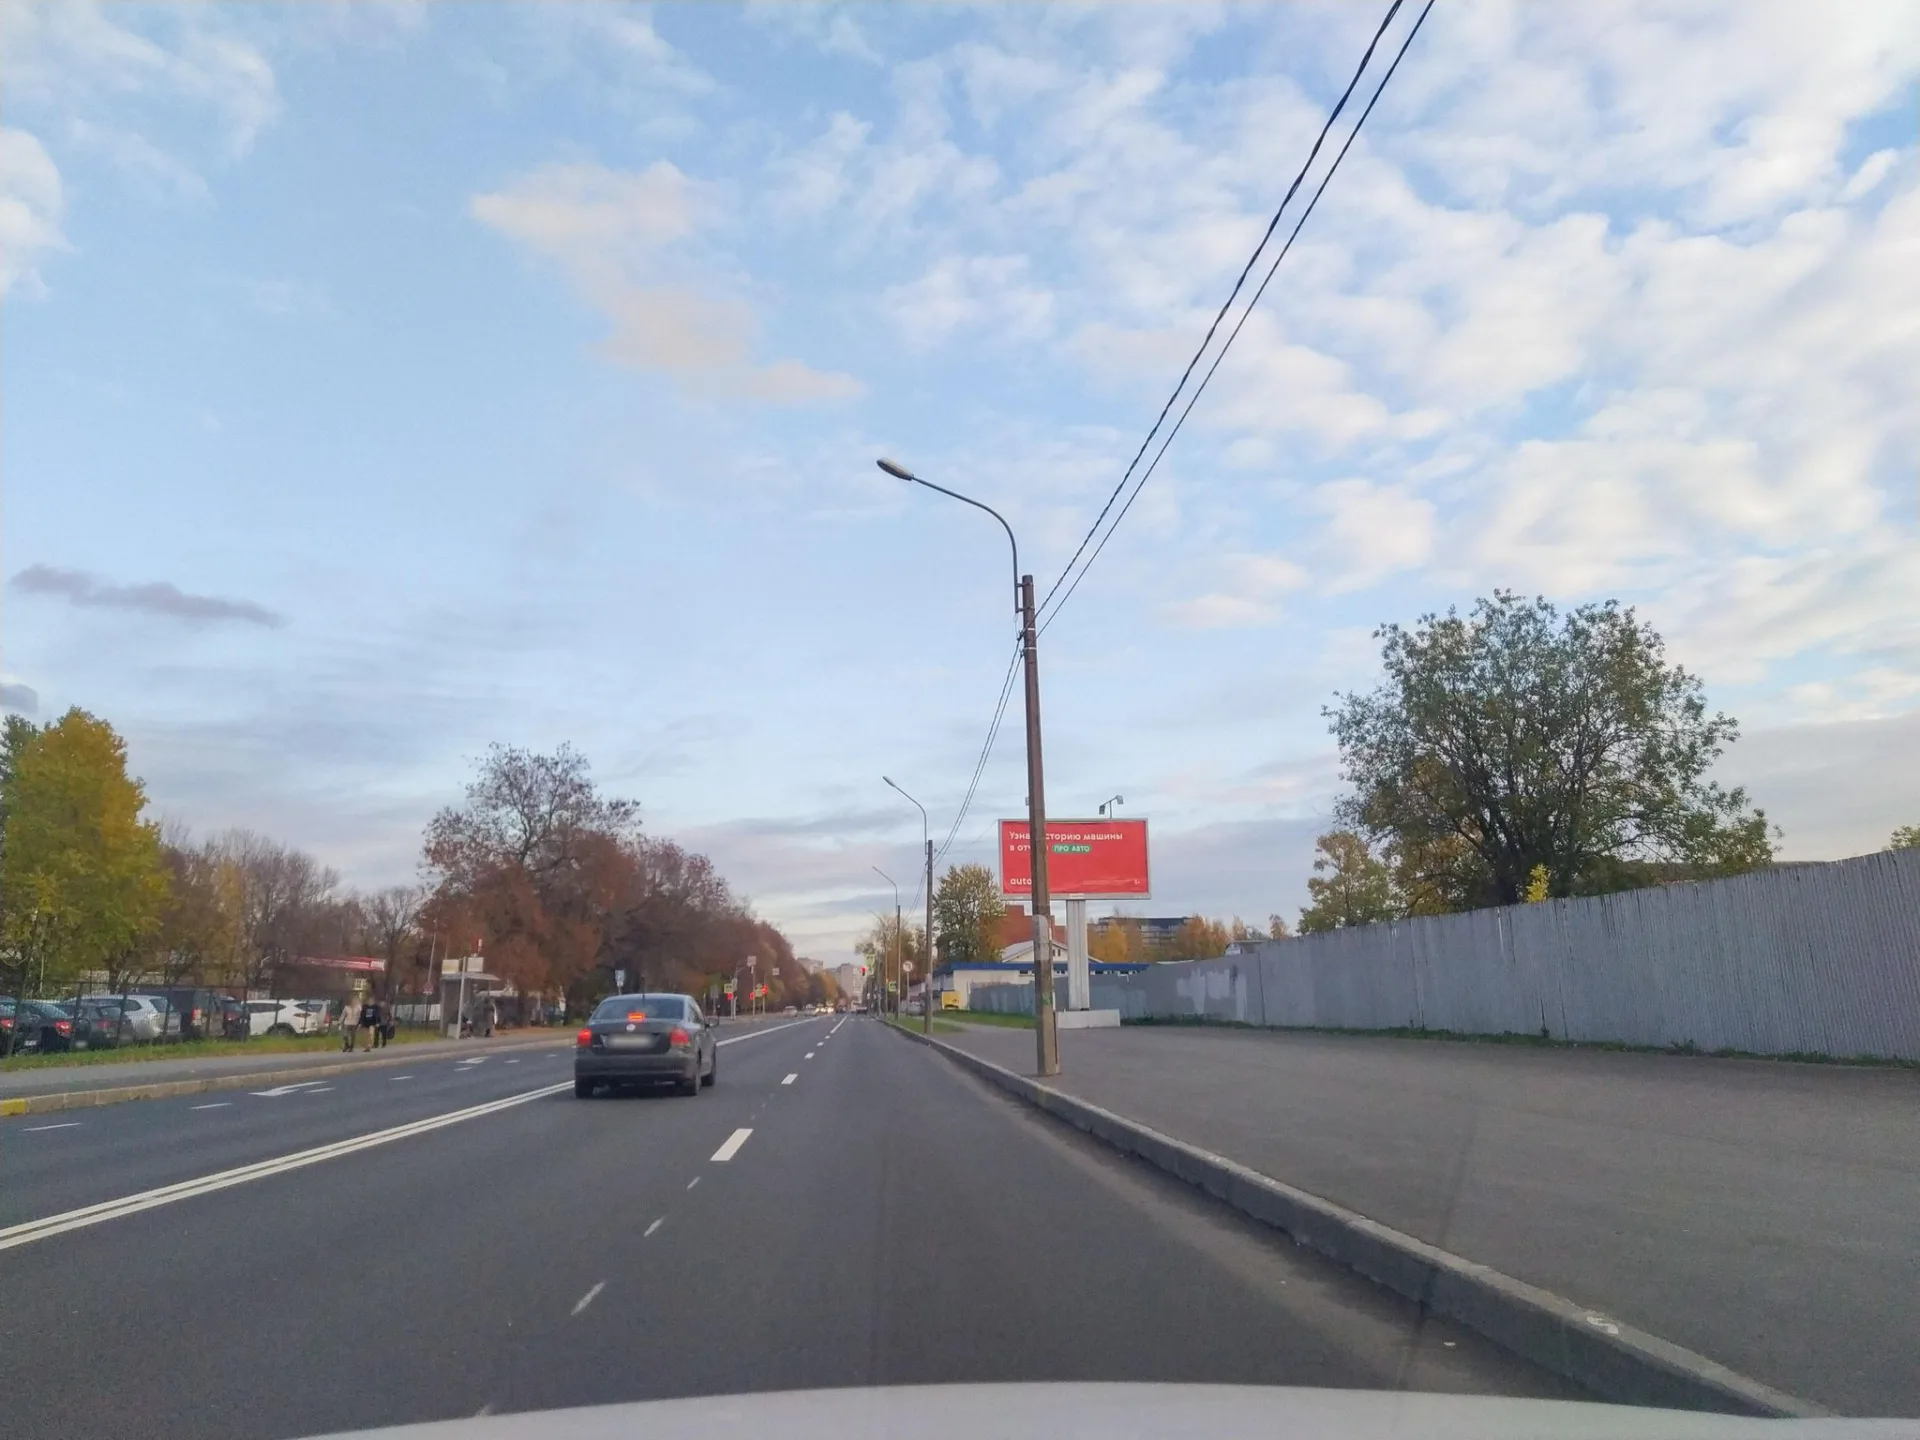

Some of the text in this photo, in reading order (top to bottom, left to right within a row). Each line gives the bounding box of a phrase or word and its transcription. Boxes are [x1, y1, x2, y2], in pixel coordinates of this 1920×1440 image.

[1009, 831, 1031, 840] Узна
[1045, 833, 1081, 842] сторию
[1010, 877, 1032, 885] auto
